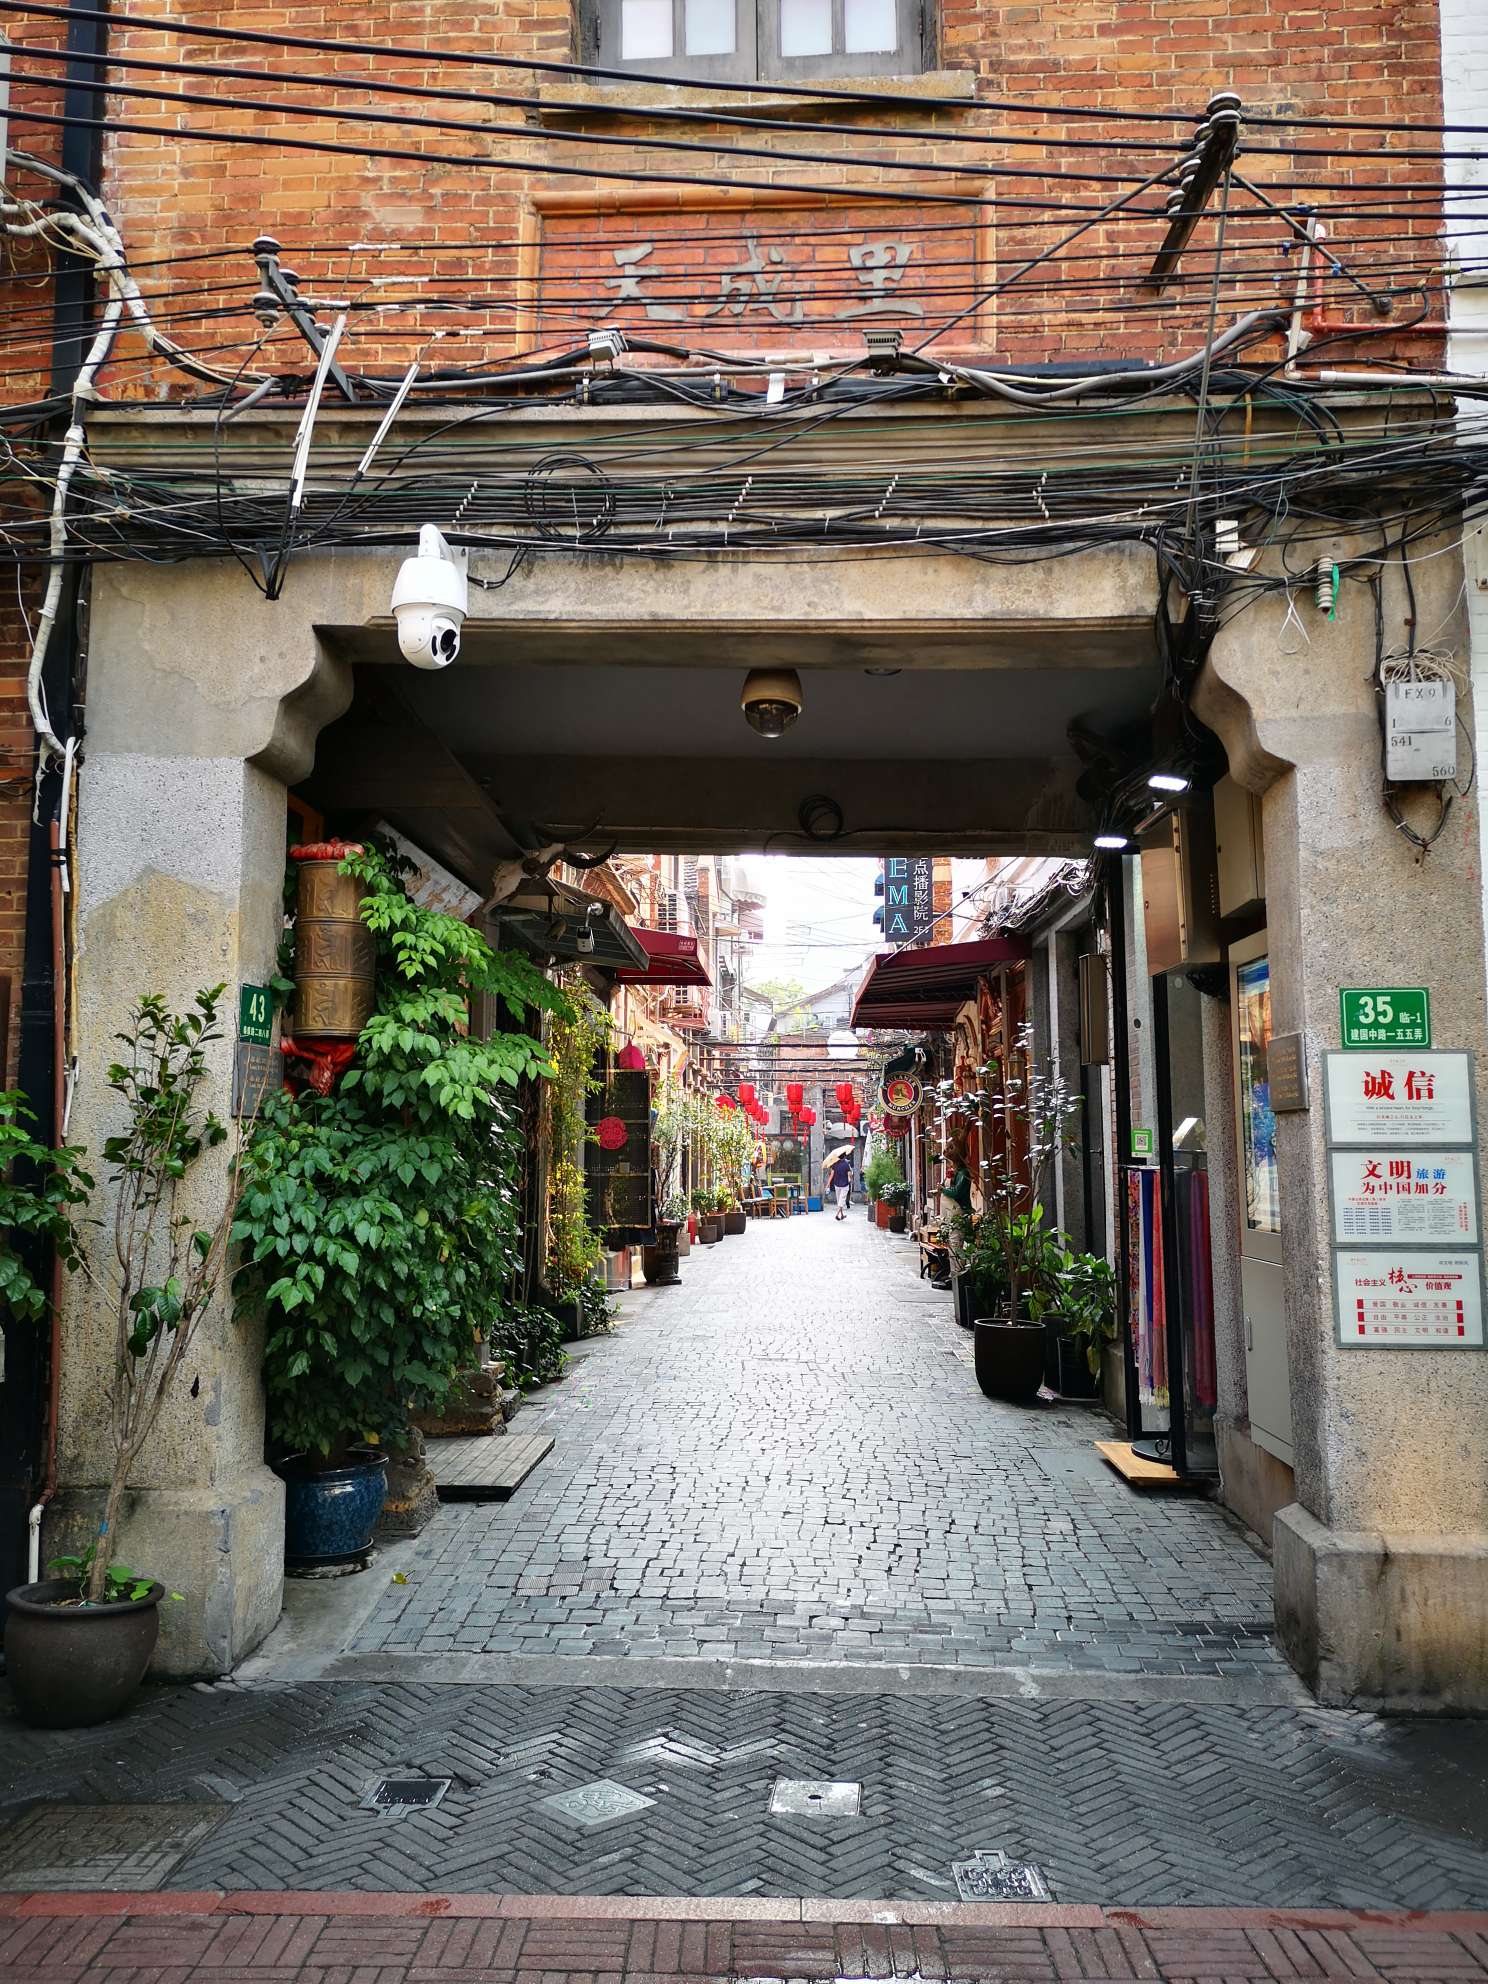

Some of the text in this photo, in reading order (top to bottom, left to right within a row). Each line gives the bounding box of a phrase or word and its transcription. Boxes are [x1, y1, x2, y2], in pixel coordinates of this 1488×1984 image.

[1391, 736, 1412, 747] 541
[1432, 765, 1455, 777] 560
[249, 993, 266, 1023] 43
[1358, 996, 1394, 1024] 35
[1351, 1028, 1423, 1040] 建国中路一五五弄
[1361, 1069, 1436, 1101] 诚信
[1361, 1159, 1447, 1180] 文明 旅游
[1361, 1181, 1448, 1196] 为中国加分
[1355, 1278, 1386, 1287] 社会主义
[1388, 1266, 1418, 1294] 核心
